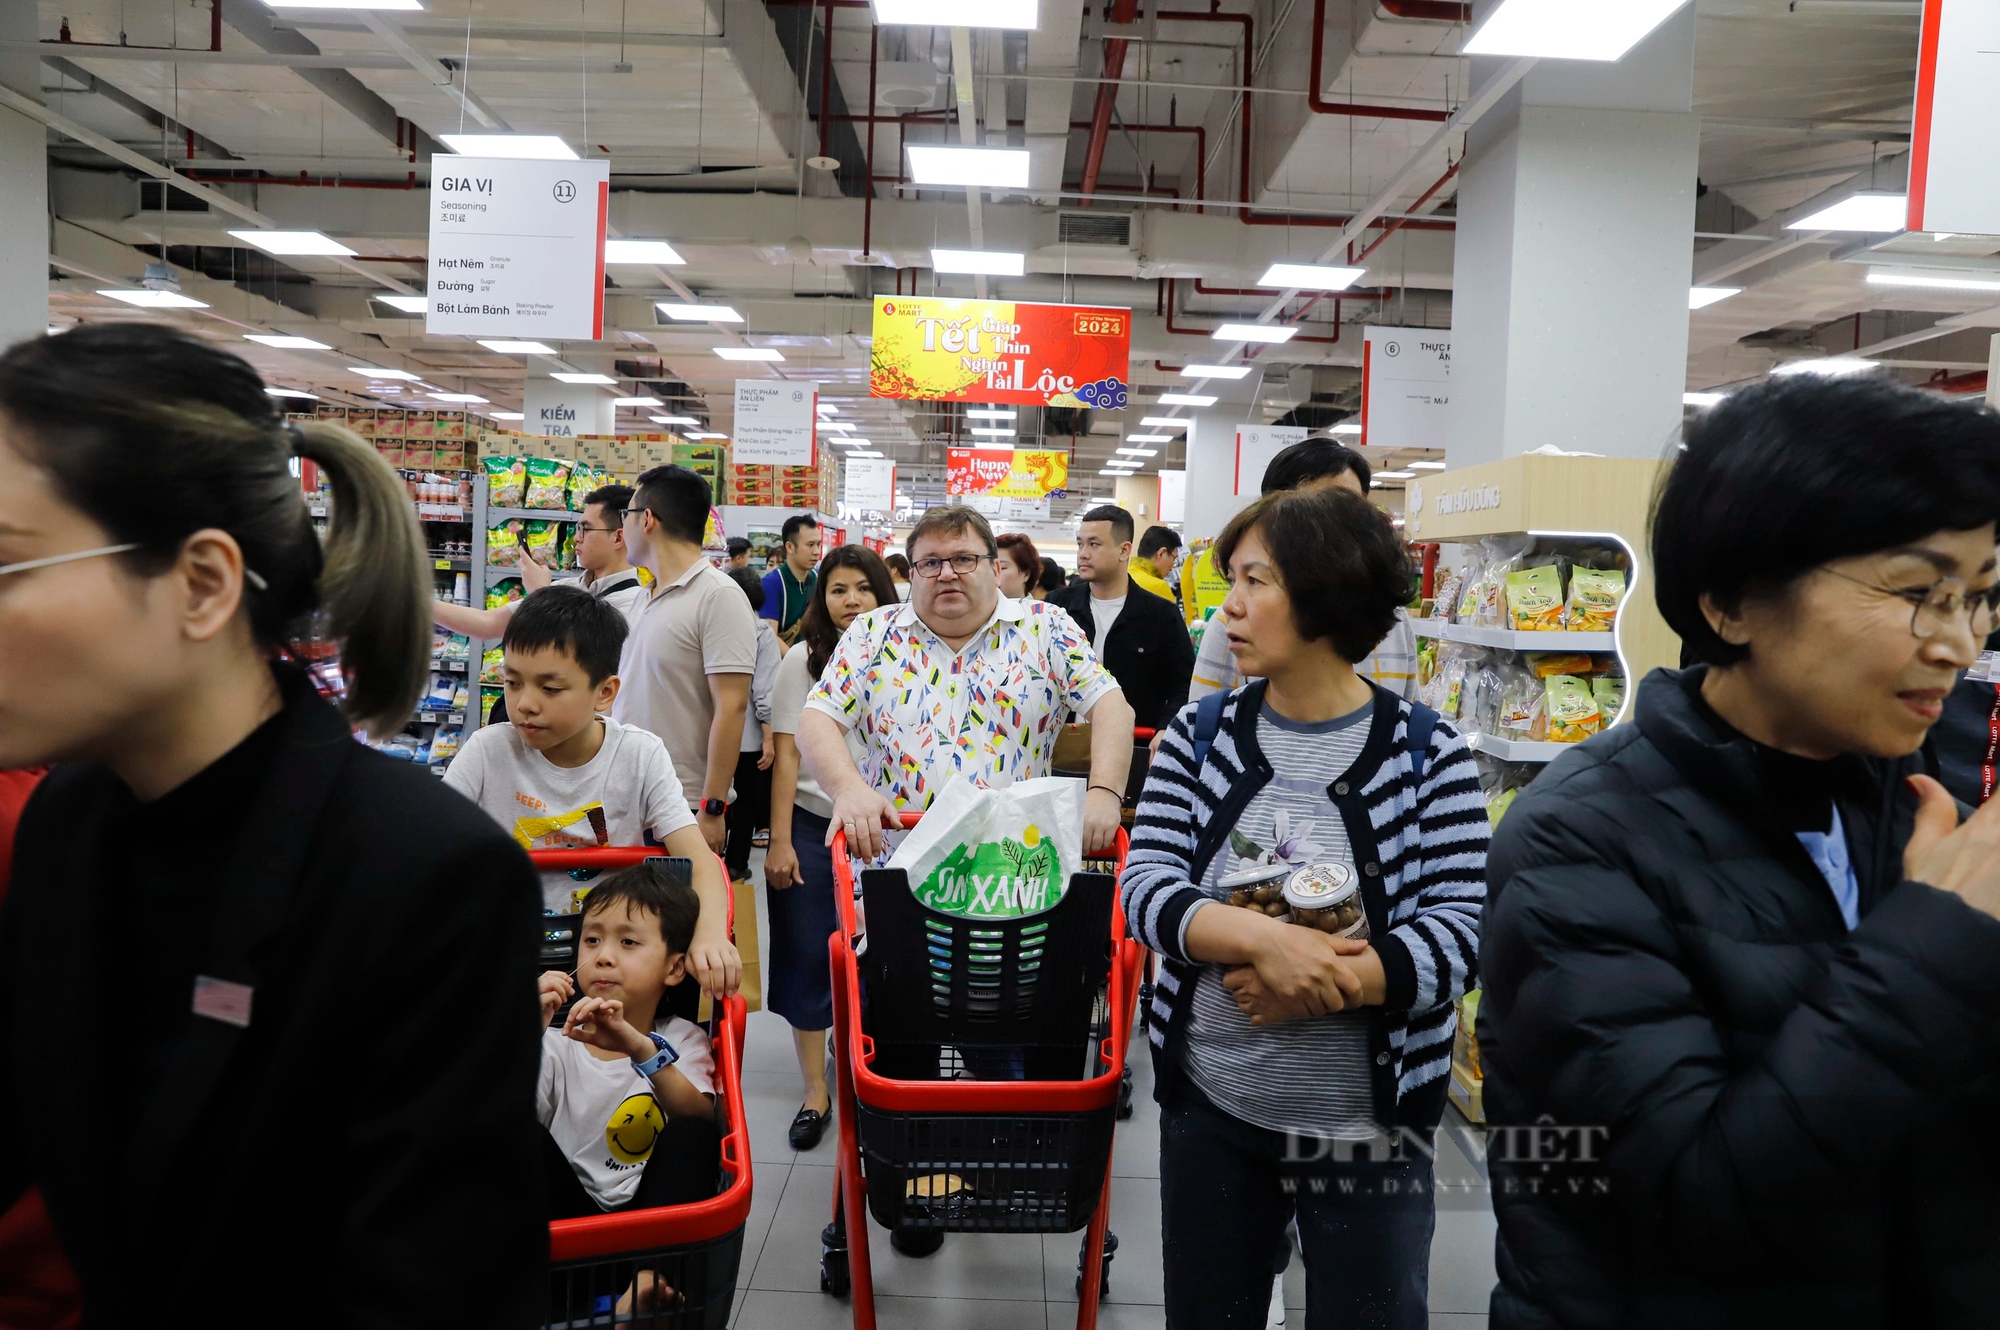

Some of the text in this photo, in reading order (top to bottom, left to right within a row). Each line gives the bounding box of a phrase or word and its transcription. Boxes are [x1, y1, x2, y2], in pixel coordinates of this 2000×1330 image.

[441, 177, 493, 196] GIA VỊ
[556, 185, 572, 197] 11
[440, 200, 487, 212] Seasoning
[440, 213, 467, 223] 조미료
[438, 258, 484, 270] Hạt Nêm
[437, 280, 474, 293] Đường
[437, 302, 510, 316] Bột Làm Bánh
[898, 309, 922, 317] MART
[981, 316, 1021, 340] Giáp
[1078, 320, 1120, 334] 2024
[915, 315, 981, 355] Tết
[990, 335, 1030, 355] Thìn
[1420, 342, 1446, 353] THỰC
[960, 356, 1008, 374] Nghìn
[982, 358, 1074, 398] Tài Lộc
[739, 388, 779, 396] THỰC PHẨM
[540, 403, 576, 421] KIỂM
[543, 424, 572, 437] TRA
[970, 458, 1011, 473] Happy
[976, 468, 1039, 482] New Year
[1987, 745, 1997, 760] Mart
[1983, 782, 1992, 798] Mart
[966, 874, 1049, 913] XANH
